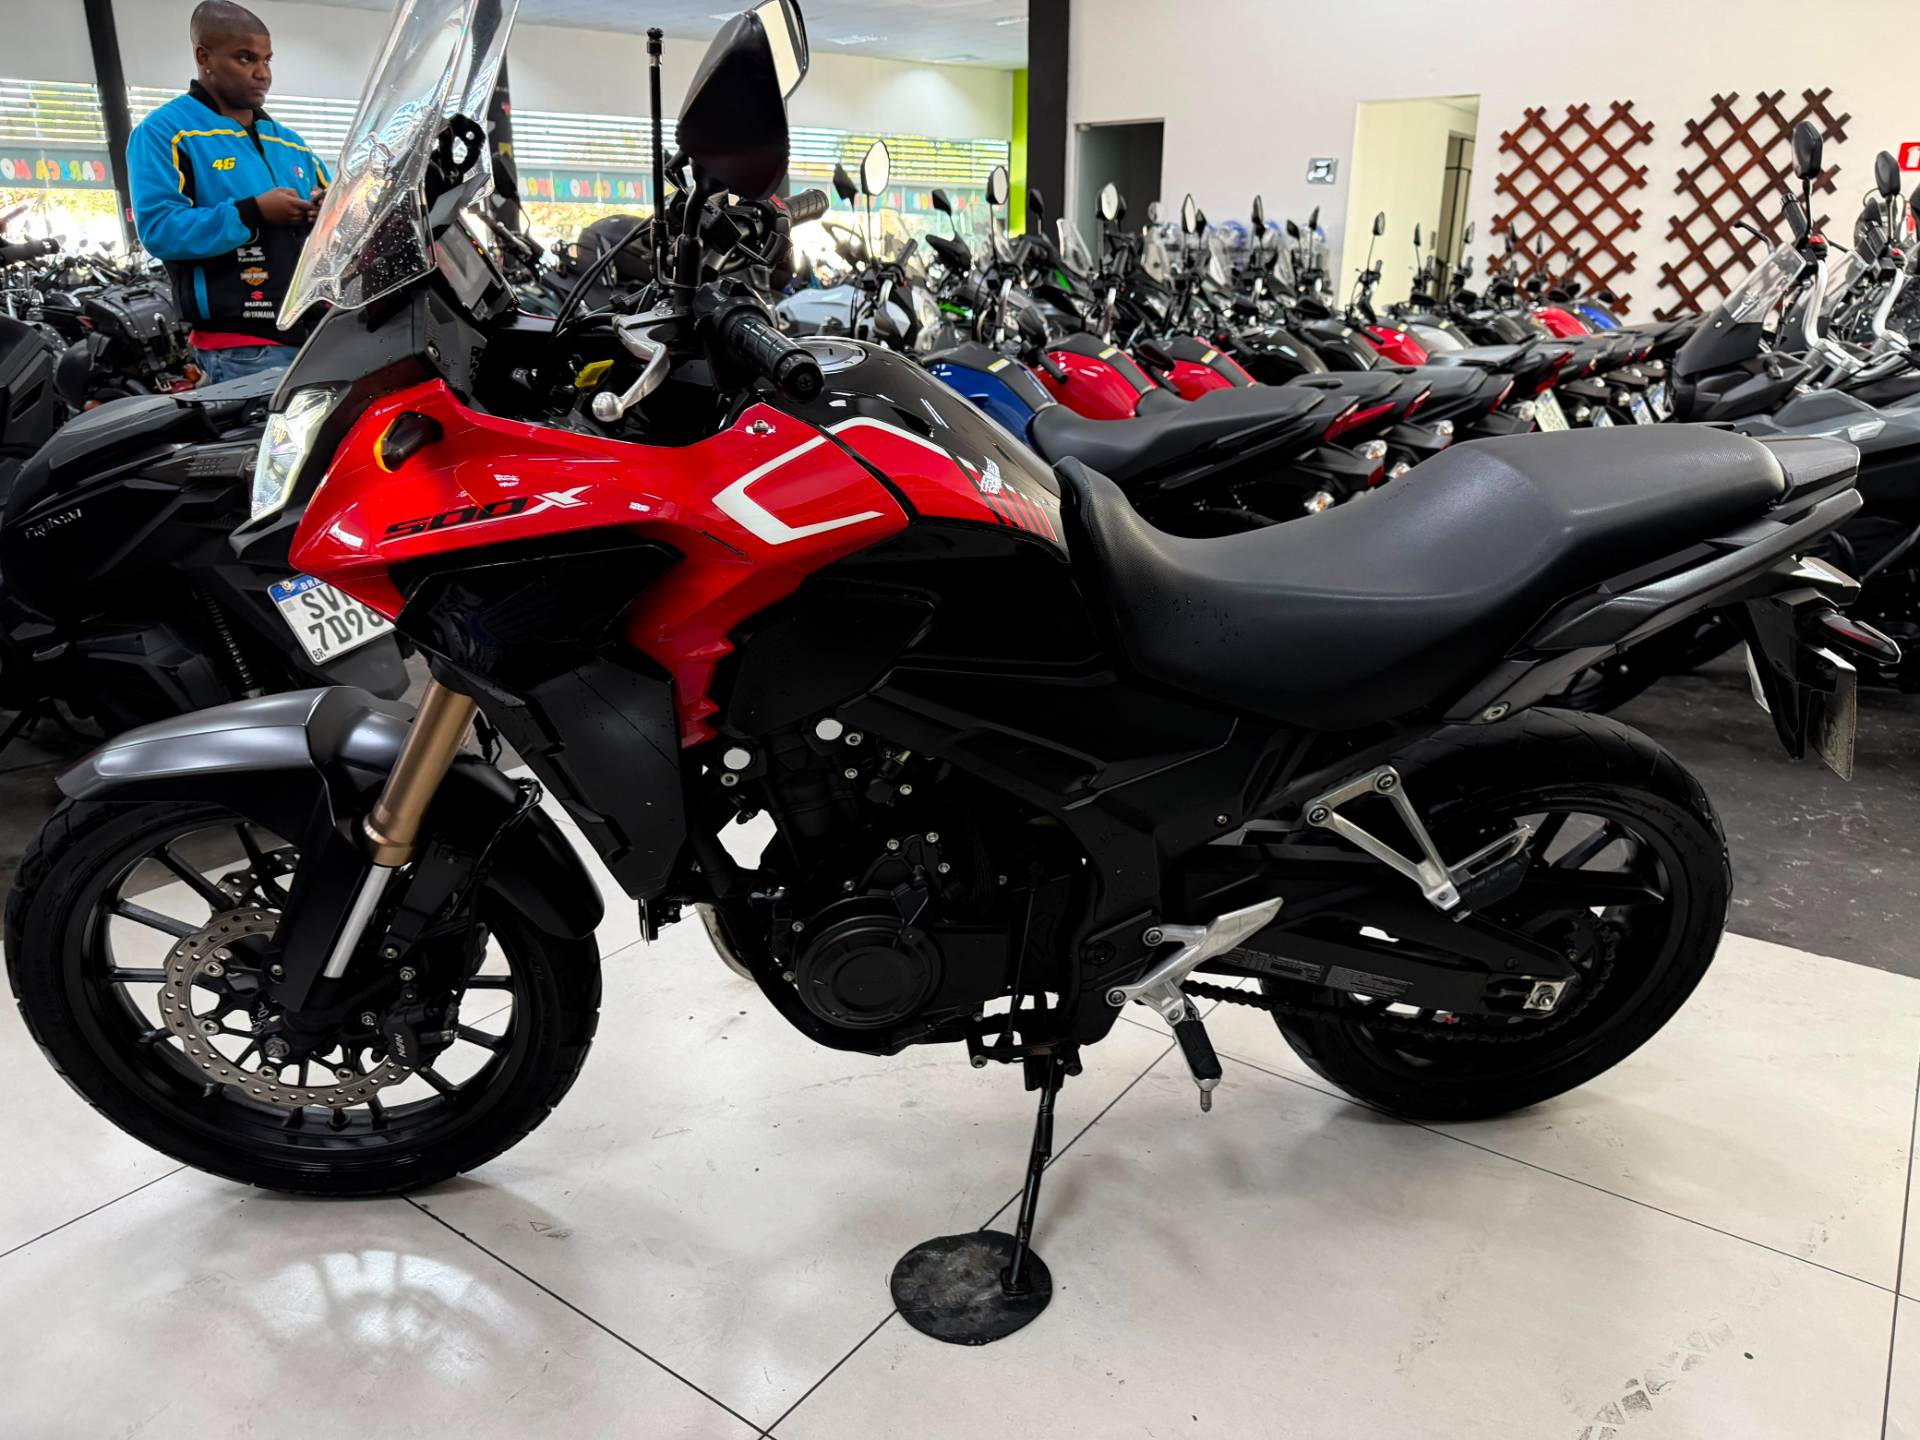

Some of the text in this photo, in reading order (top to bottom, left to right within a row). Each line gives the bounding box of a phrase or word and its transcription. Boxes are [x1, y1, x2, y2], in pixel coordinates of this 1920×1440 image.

[212, 157, 236, 171] 46
[381, 484, 593, 542] 500X
[299, 578, 321, 590] BRA
[312, 648, 326, 660] BR
